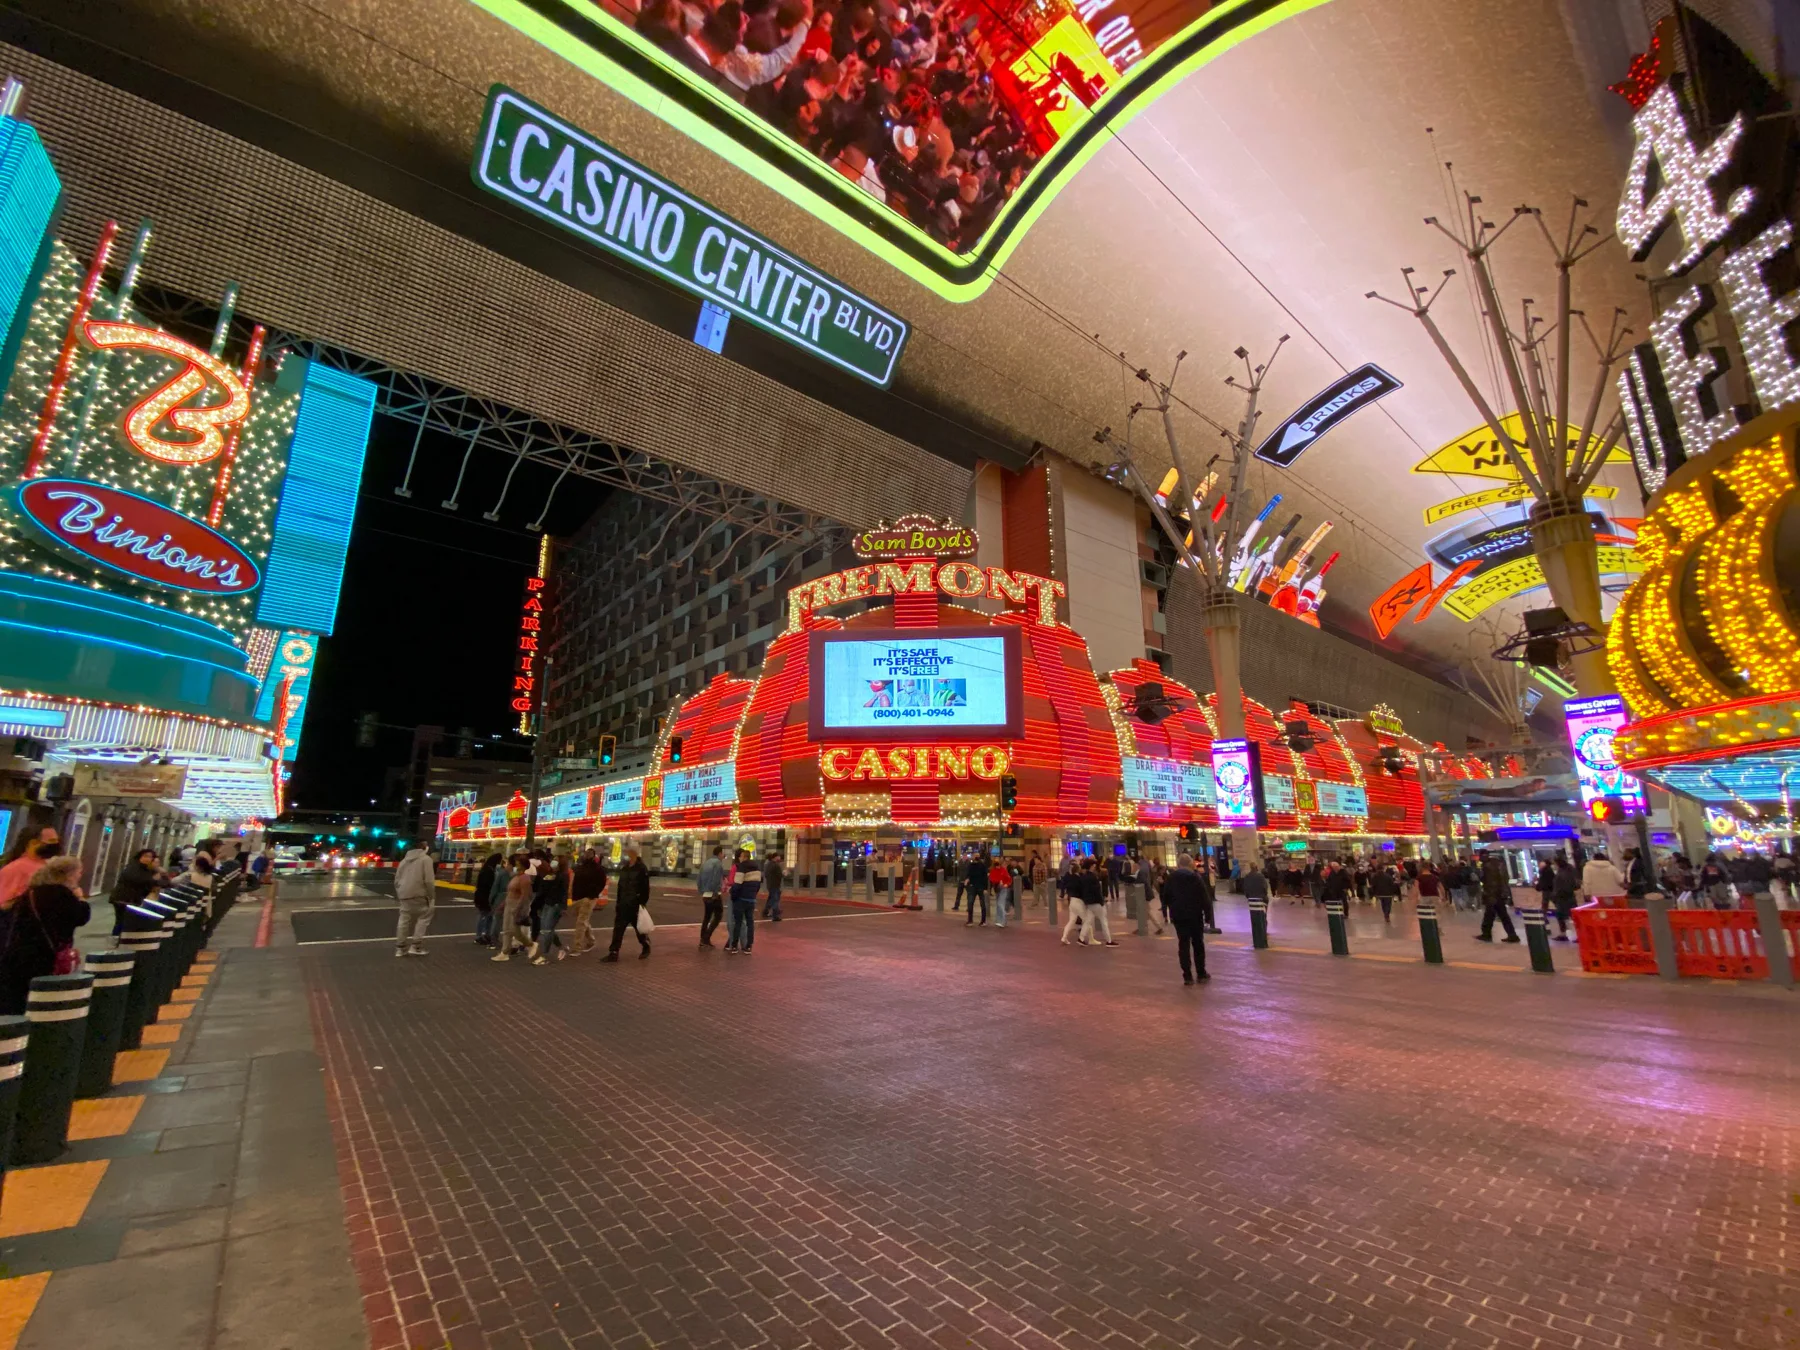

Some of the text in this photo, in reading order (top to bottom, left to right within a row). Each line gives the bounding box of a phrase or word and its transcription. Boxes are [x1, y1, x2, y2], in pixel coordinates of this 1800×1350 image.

[1616, 79, 1757, 277] 4
[509, 123, 894, 357] CASINO CENTER BLVD.
[84, 321, 249, 465] B
[1300, 380, 1377, 432] DRINKS
[1438, 494, 1490, 515] FREE
[48, 490, 242, 586] Binion's
[860, 530, 972, 552] Sam Boyd's
[788, 563, 1065, 633] FREMONT
[1457, 563, 1540, 600] LOOKI
[512, 577, 545, 711] PARKING
[873, 656, 953, 666] IT'S EFFECTIVE
[888, 648, 938, 657] IT'S SAFE
[889, 666, 938, 675] IT'S FREE
[873, 708, 954, 719] (800) 401-0946
[821, 745, 1010, 780] CASINO
[1136, 759, 1158, 772] DRAFT
[1180, 765, 1205, 777] SPECIAL
